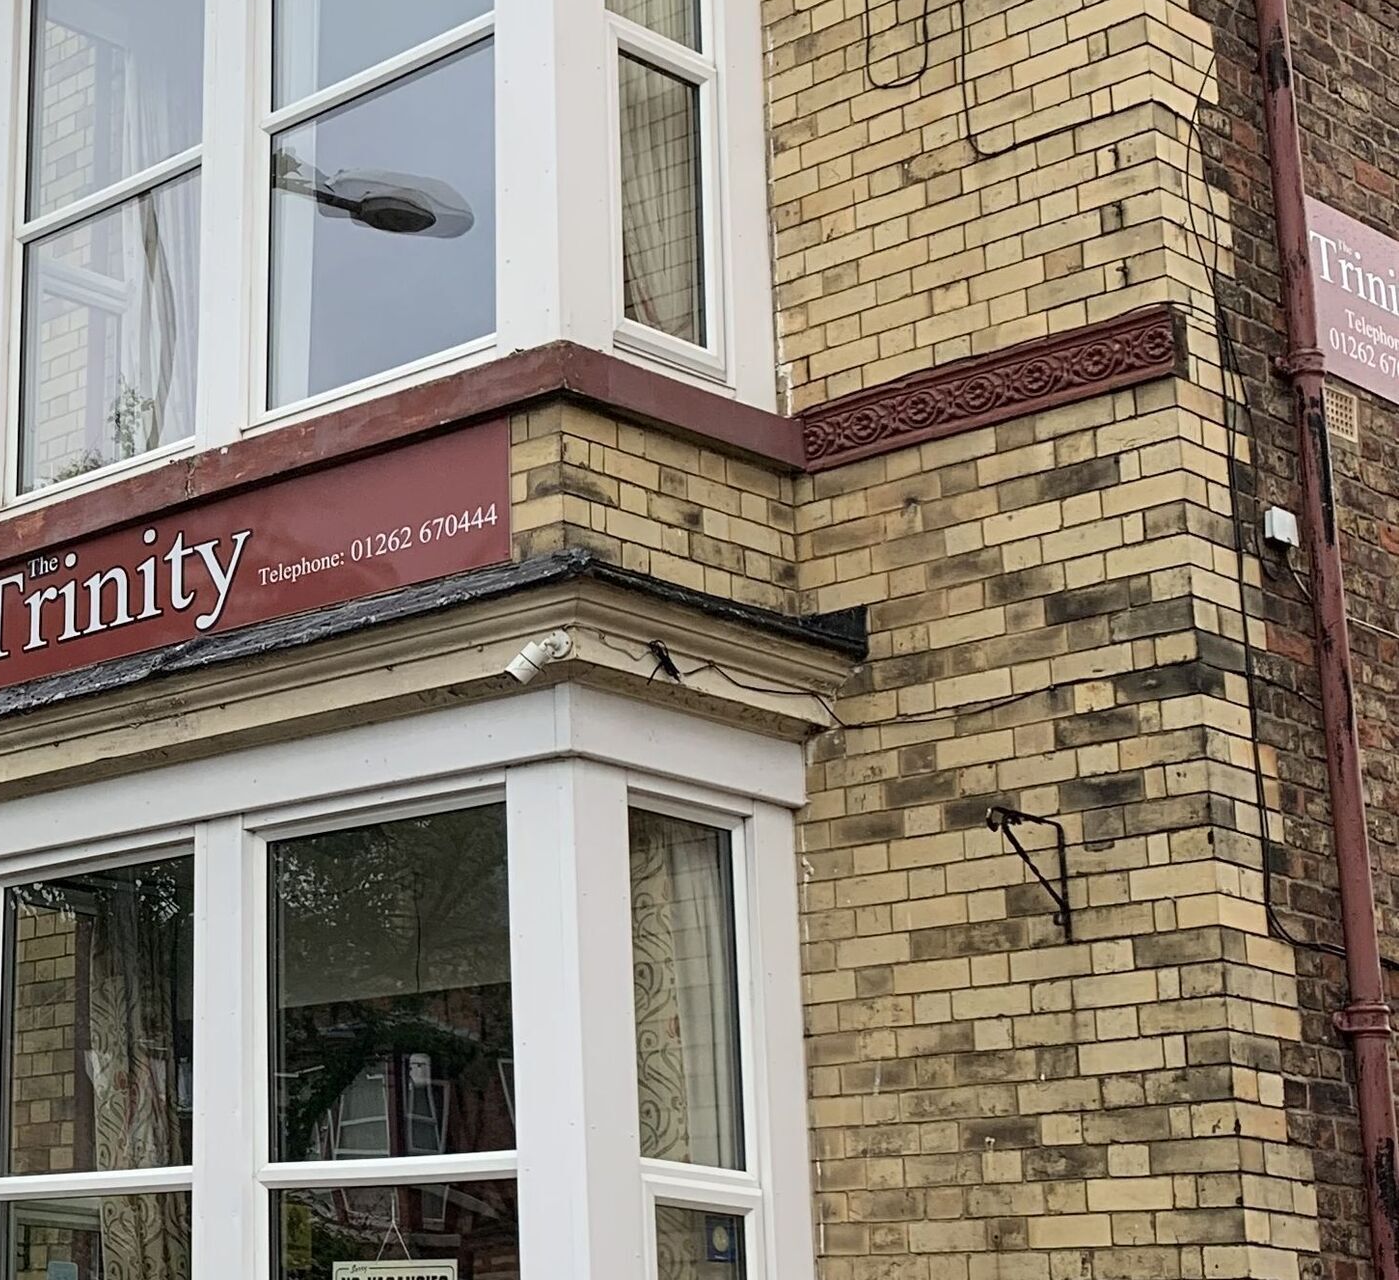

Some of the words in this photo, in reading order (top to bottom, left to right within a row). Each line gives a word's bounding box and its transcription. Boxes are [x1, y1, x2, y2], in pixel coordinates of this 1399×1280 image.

[1338, 240, 1353, 256] The
[1329, 327, 1376, 368] 01262
[1380, 352, 1399, 379] 67
[258, 551, 345, 586] Telephone:
[350, 526, 413, 562] 01262
[419, 503, 498, 544] 670444
[28, 555, 58, 578] The
